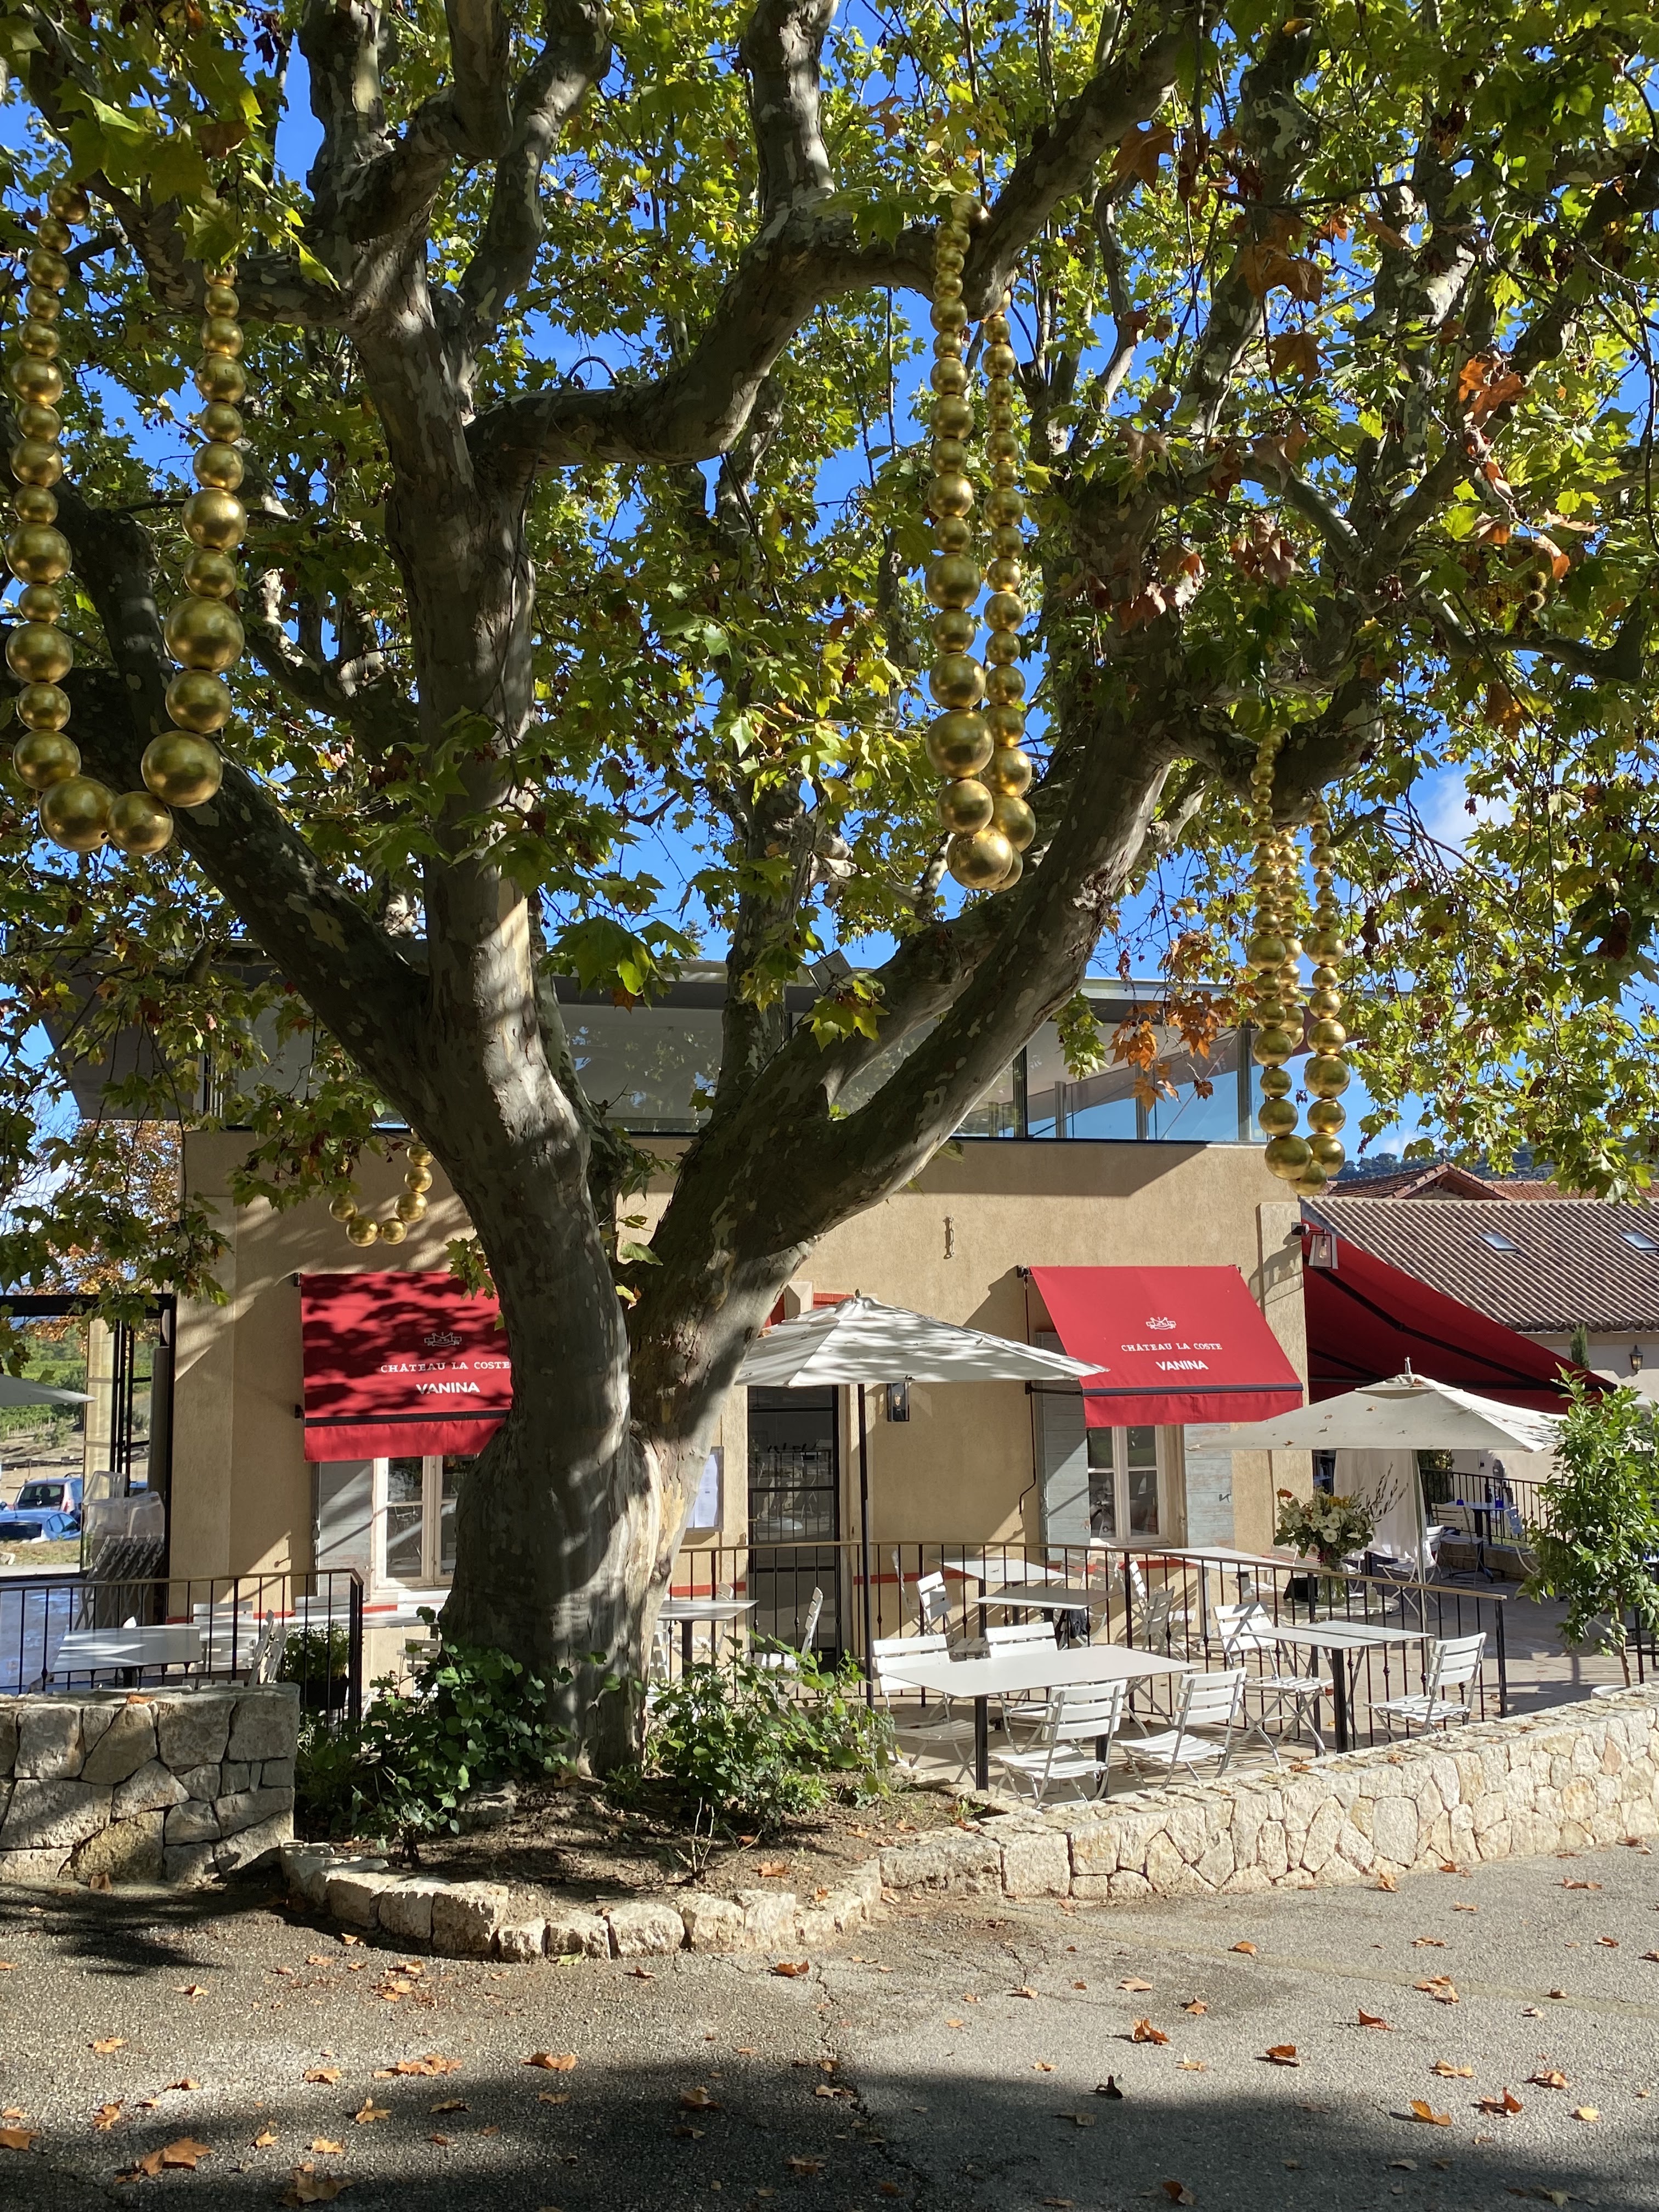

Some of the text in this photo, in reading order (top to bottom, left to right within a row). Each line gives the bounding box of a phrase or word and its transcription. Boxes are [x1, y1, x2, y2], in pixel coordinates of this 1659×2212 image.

[1121, 1343, 1172, 1352] CHÂTEAU
[380, 1361, 510, 1373] CHÂTEAU LA COSTE
[1155, 1360, 1209, 1370] VANINA
[416, 1382, 481, 1394] VANINA
